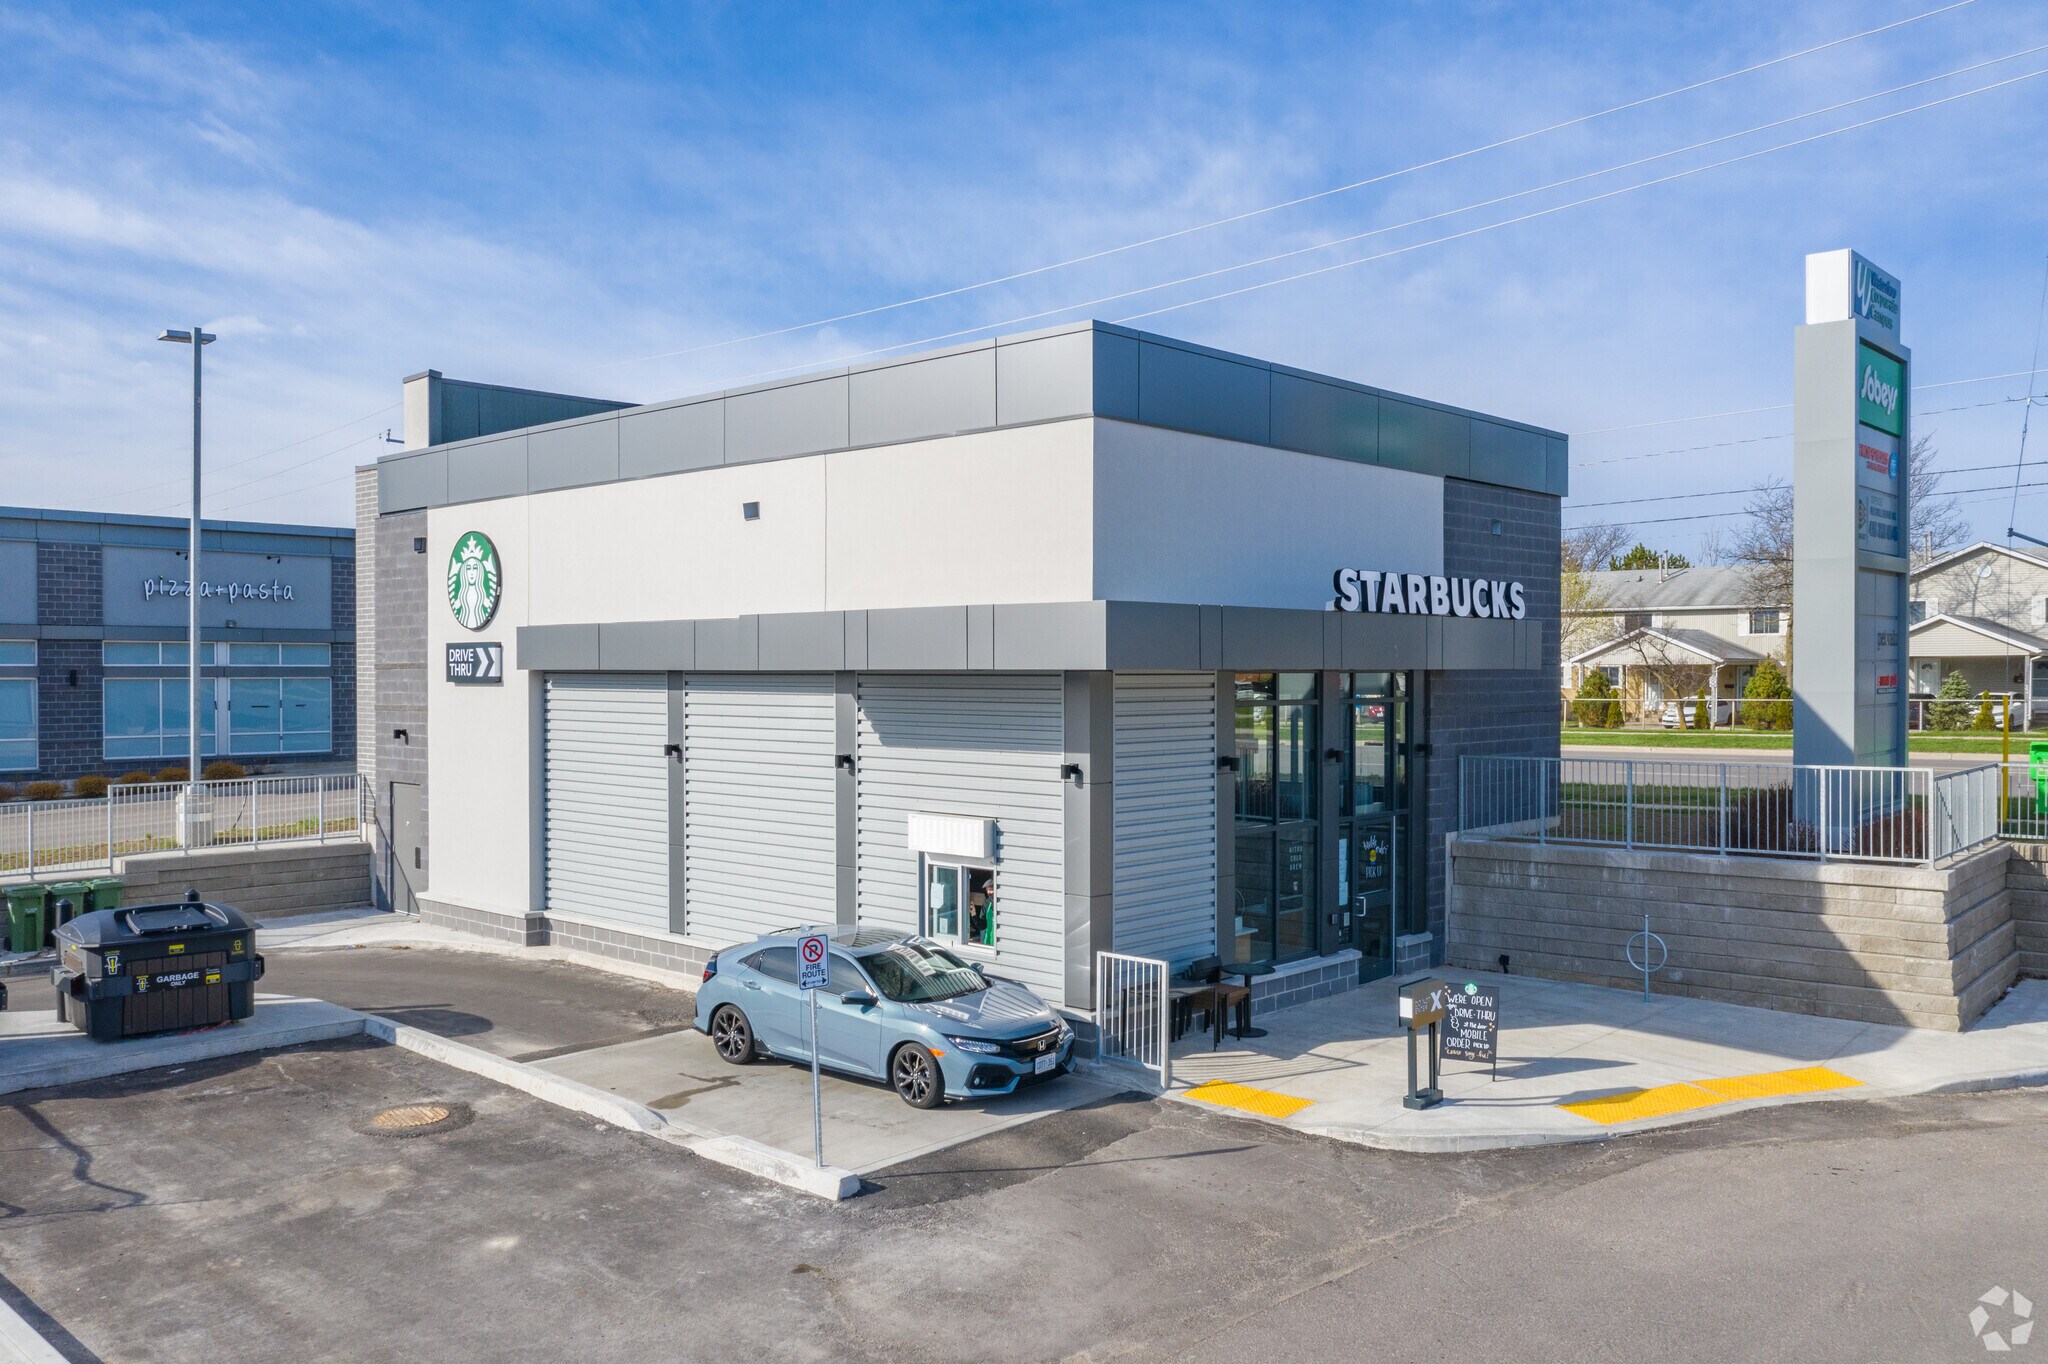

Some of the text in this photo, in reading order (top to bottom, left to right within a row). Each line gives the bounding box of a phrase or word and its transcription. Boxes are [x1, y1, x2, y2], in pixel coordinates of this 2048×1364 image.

[1861, 364, 1898, 416] Sobeys
[1335, 567, 1526, 620] STARBUCKS
[449, 648, 474, 662] DRIVE
[449, 663, 473, 677] THRU
[805, 962, 822, 971] FIRE
[156, 971, 200, 984] GARBAGE
[802, 968, 826, 980] ROUTE
[170, 980, 187, 988] ONLY
[1471, 996, 1493, 1007] OPEN
[1460, 1029, 1488, 1041] MOBILE
[1446, 1037, 1471, 1049] ORDER
